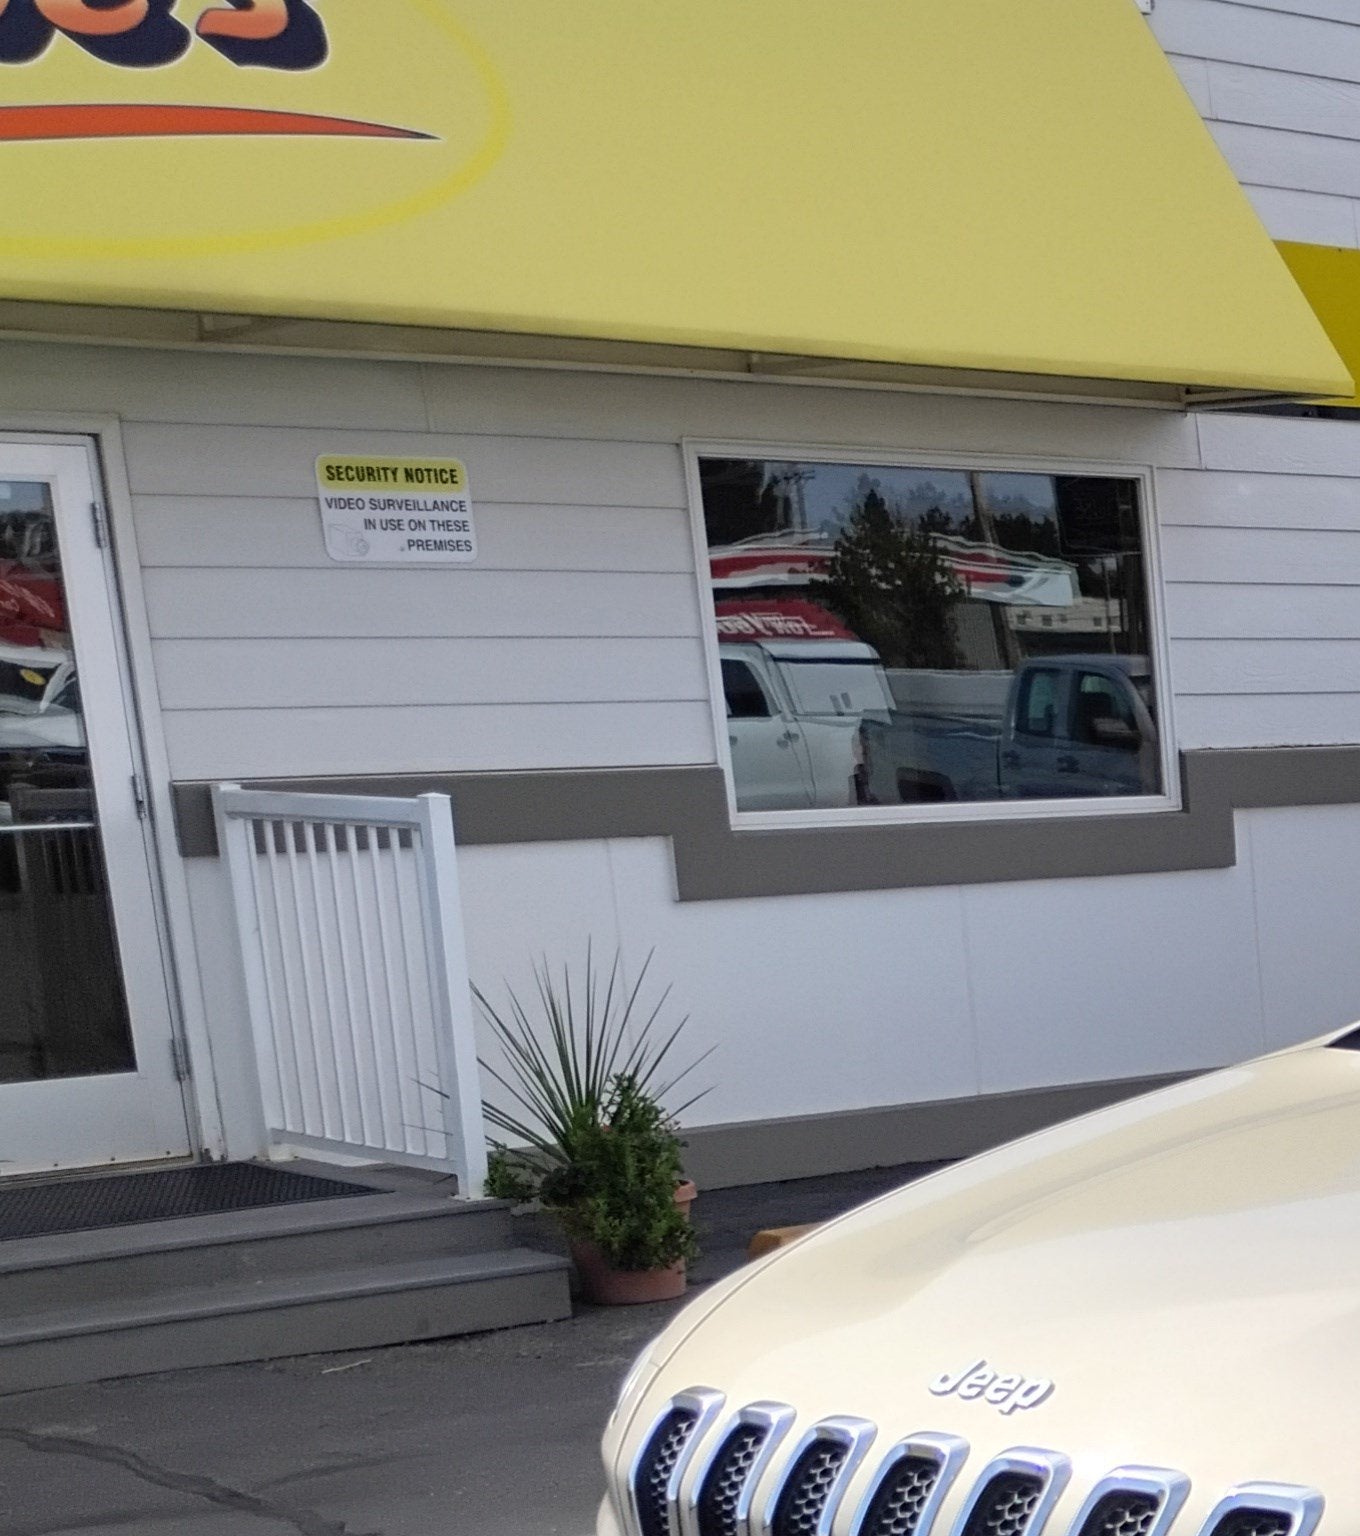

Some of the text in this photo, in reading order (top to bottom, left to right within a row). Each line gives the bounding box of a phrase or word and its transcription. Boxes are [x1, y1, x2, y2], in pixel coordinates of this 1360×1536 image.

[325, 465, 459, 485] SECURITY NOTICE
[325, 497, 468, 513] VIDEO SURVEILLANCE
[364, 518, 471, 533] IN USE ON THESE
[407, 538, 473, 553] PREMISES
[928, 1360, 1056, 1416] Jeep
